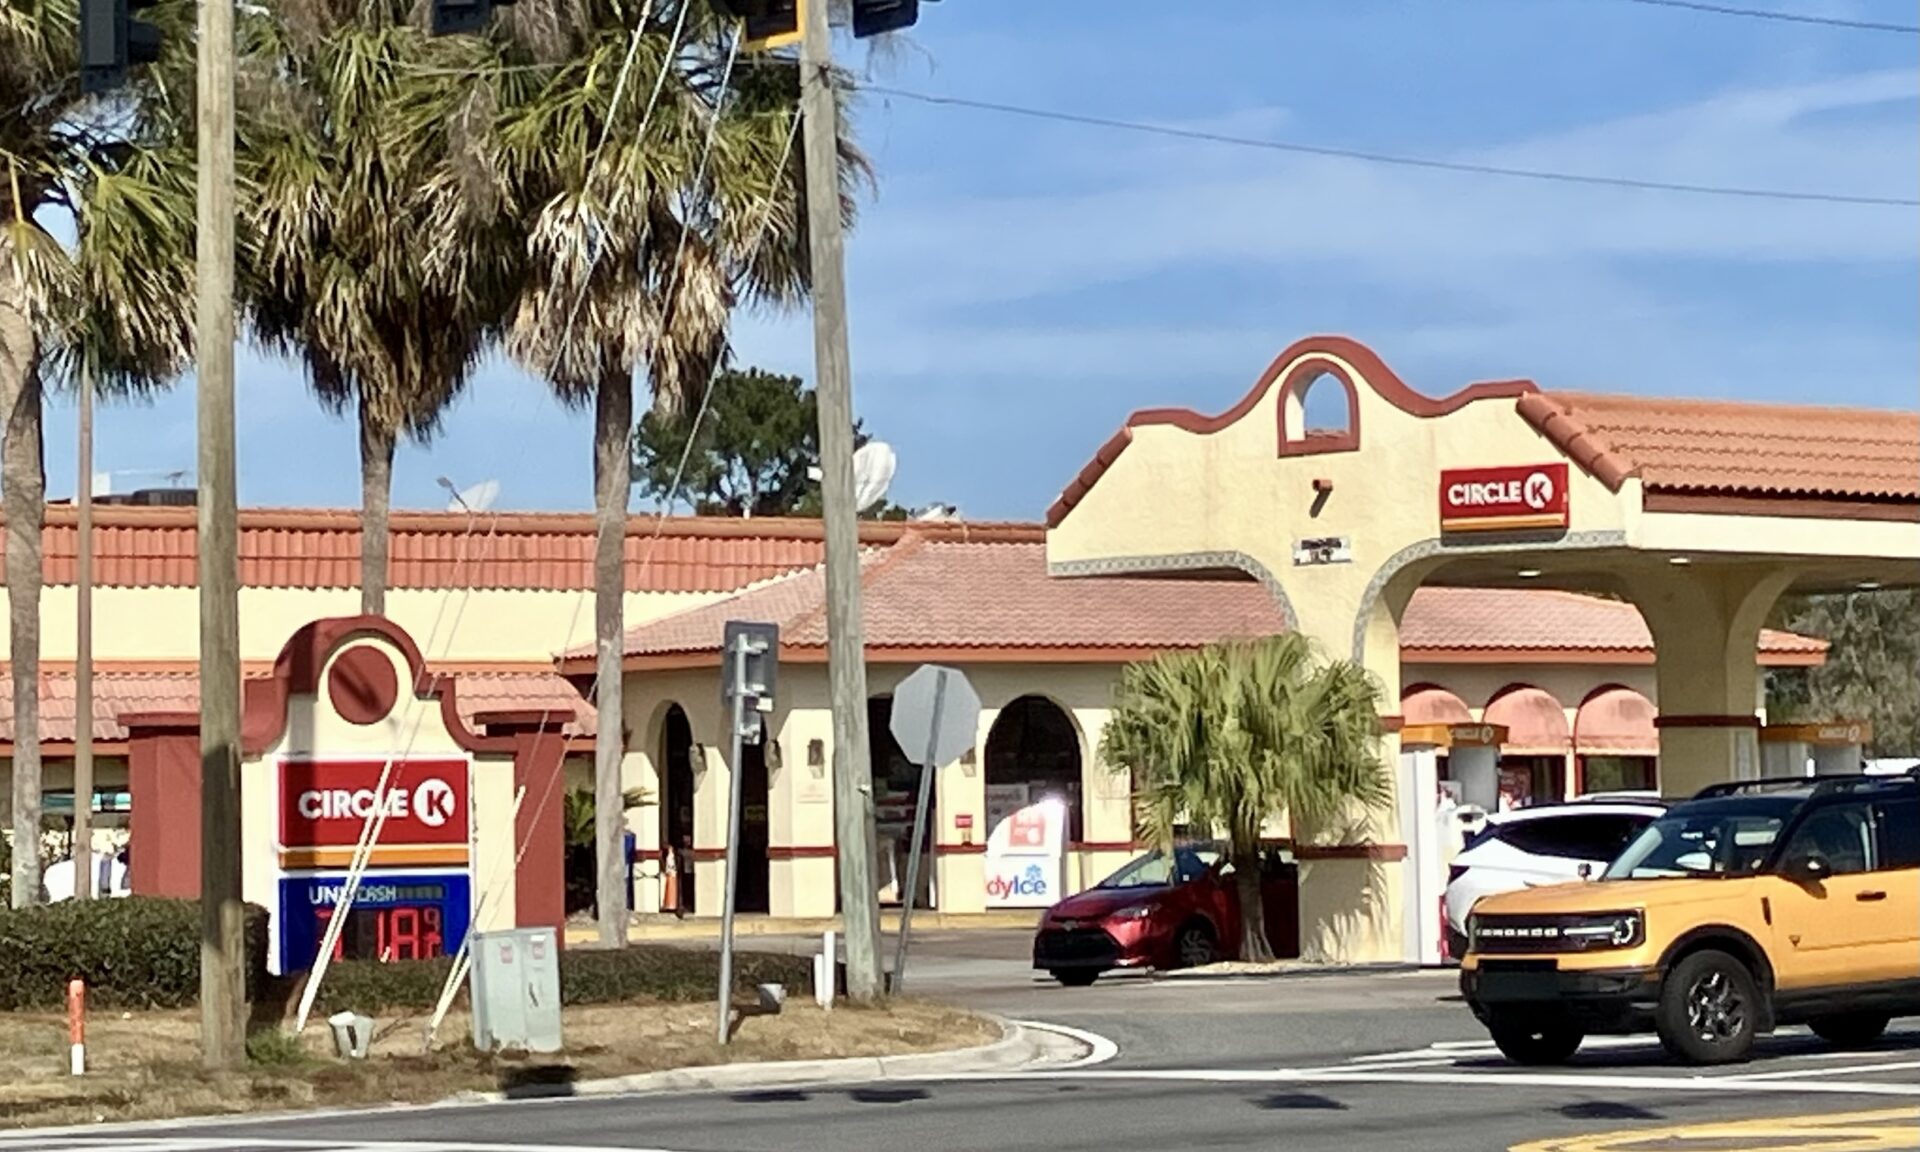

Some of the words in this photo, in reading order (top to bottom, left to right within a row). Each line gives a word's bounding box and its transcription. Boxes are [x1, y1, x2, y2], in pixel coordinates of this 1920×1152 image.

[1448, 480, 1521, 506] CIRCLE
[1525, 474, 1552, 508] K
[416, 781, 454, 825] K
[309, 885, 350, 904] UN
